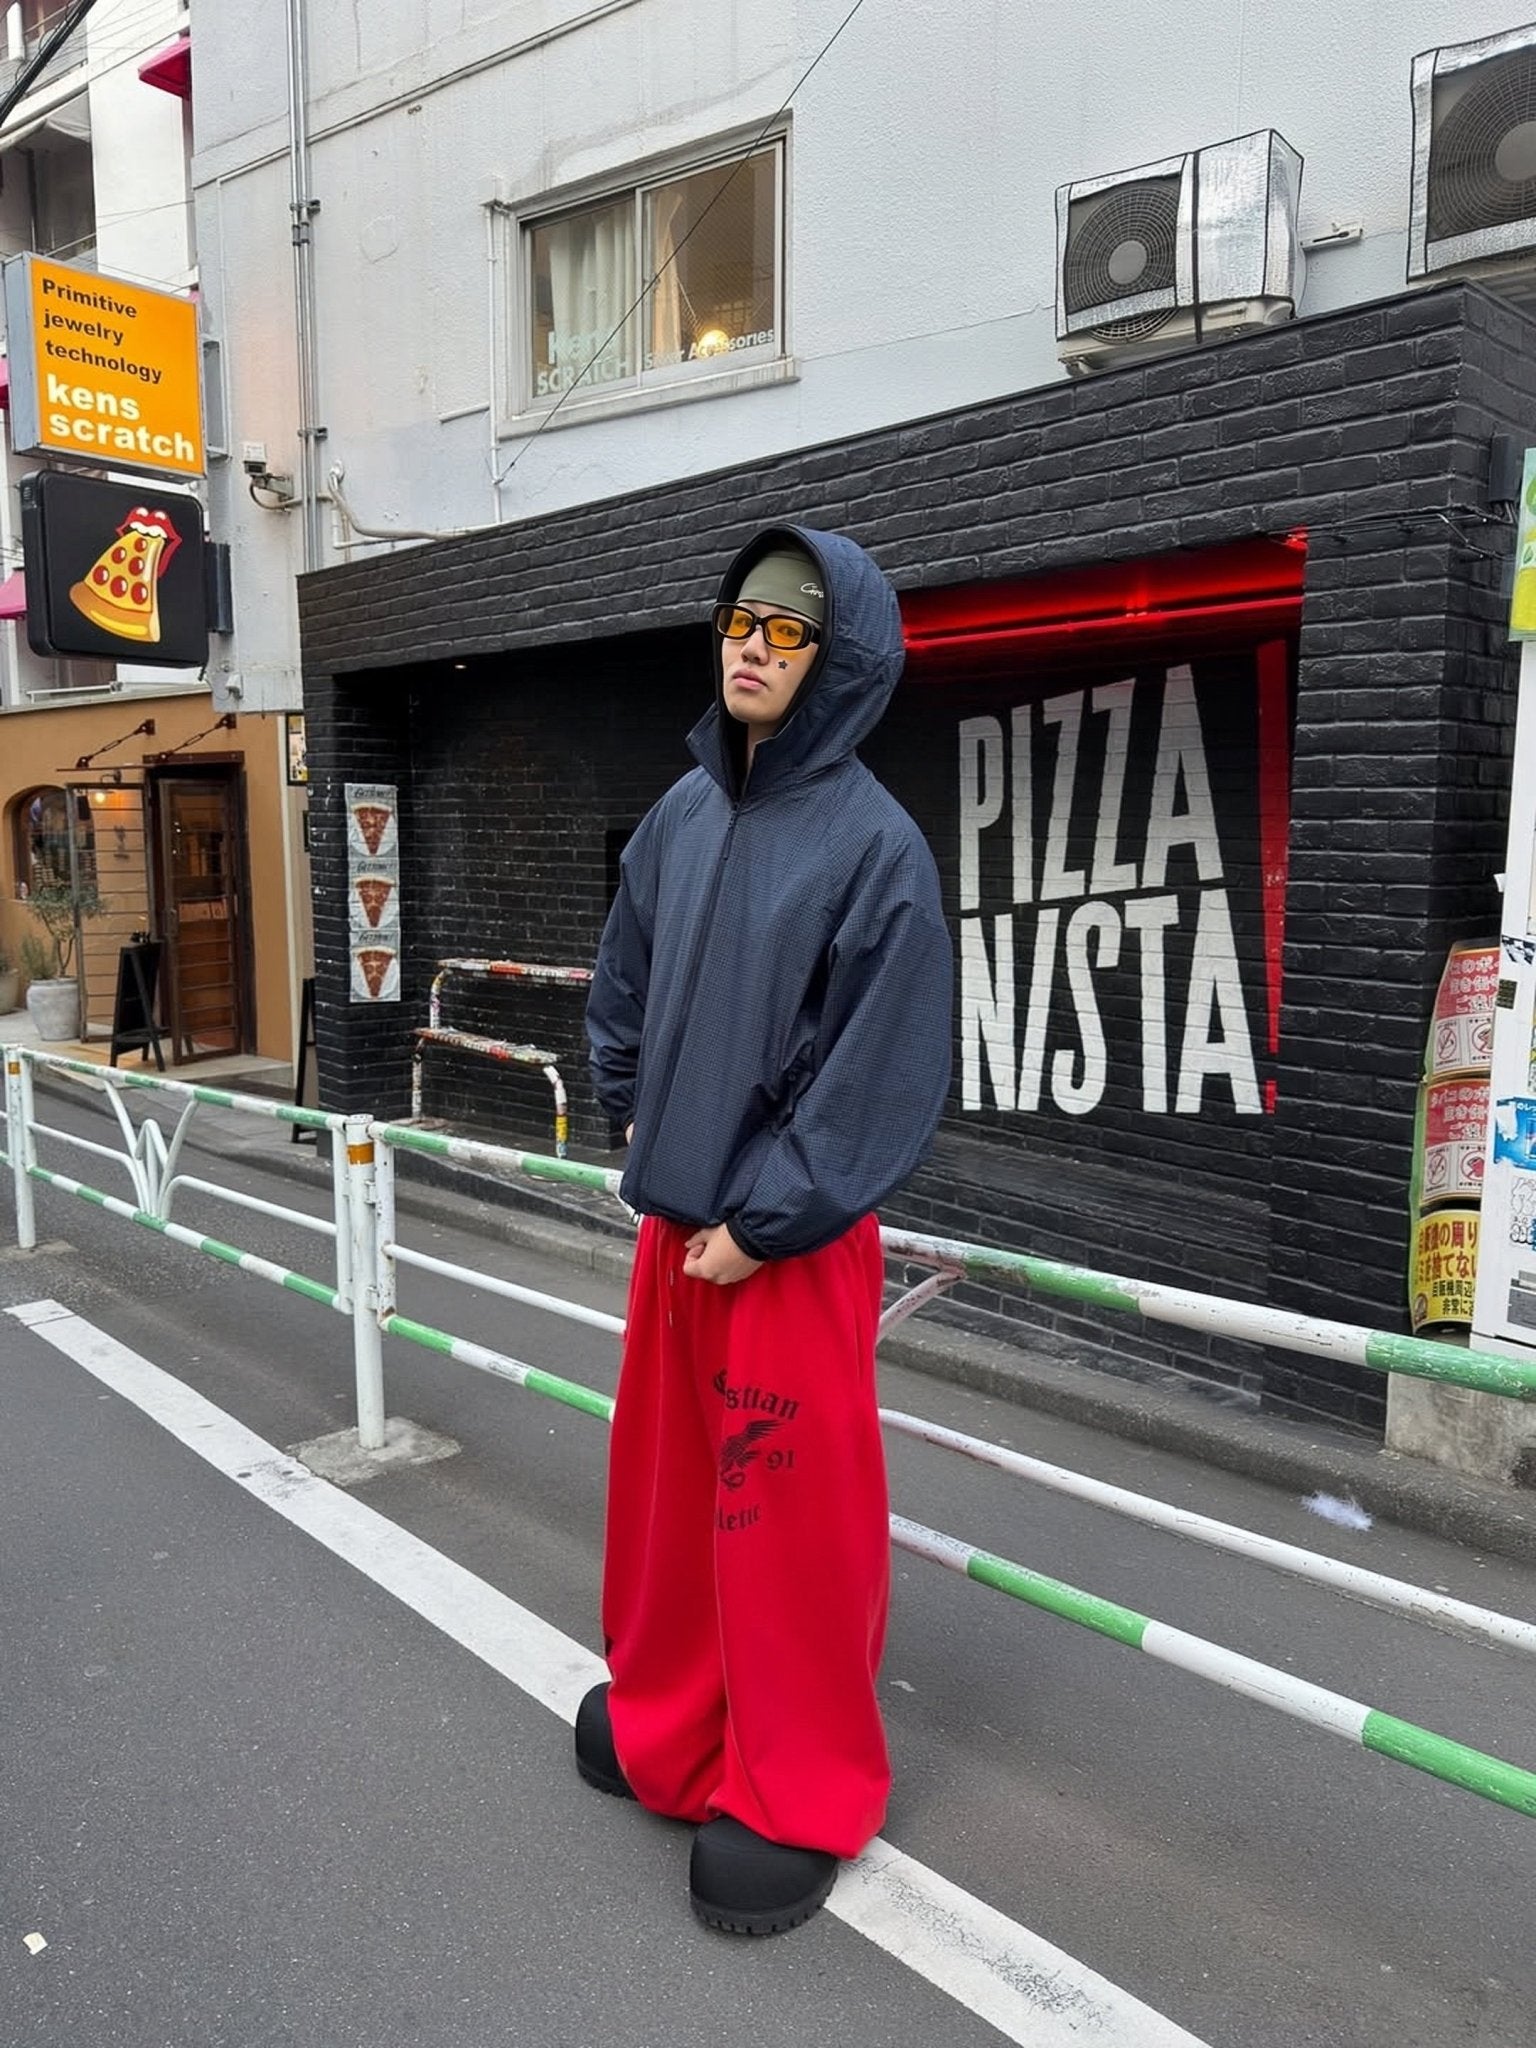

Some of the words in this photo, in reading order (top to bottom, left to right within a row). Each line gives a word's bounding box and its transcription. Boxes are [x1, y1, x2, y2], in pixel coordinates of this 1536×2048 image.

[42, 278, 137, 318] Primitive
[43, 308, 124, 347] jewelry
[45, 340, 162, 384] technology
[47, 373, 141, 421] kens
[49, 413, 195, 462] scratch
[959, 664, 1224, 911] PIZZA
